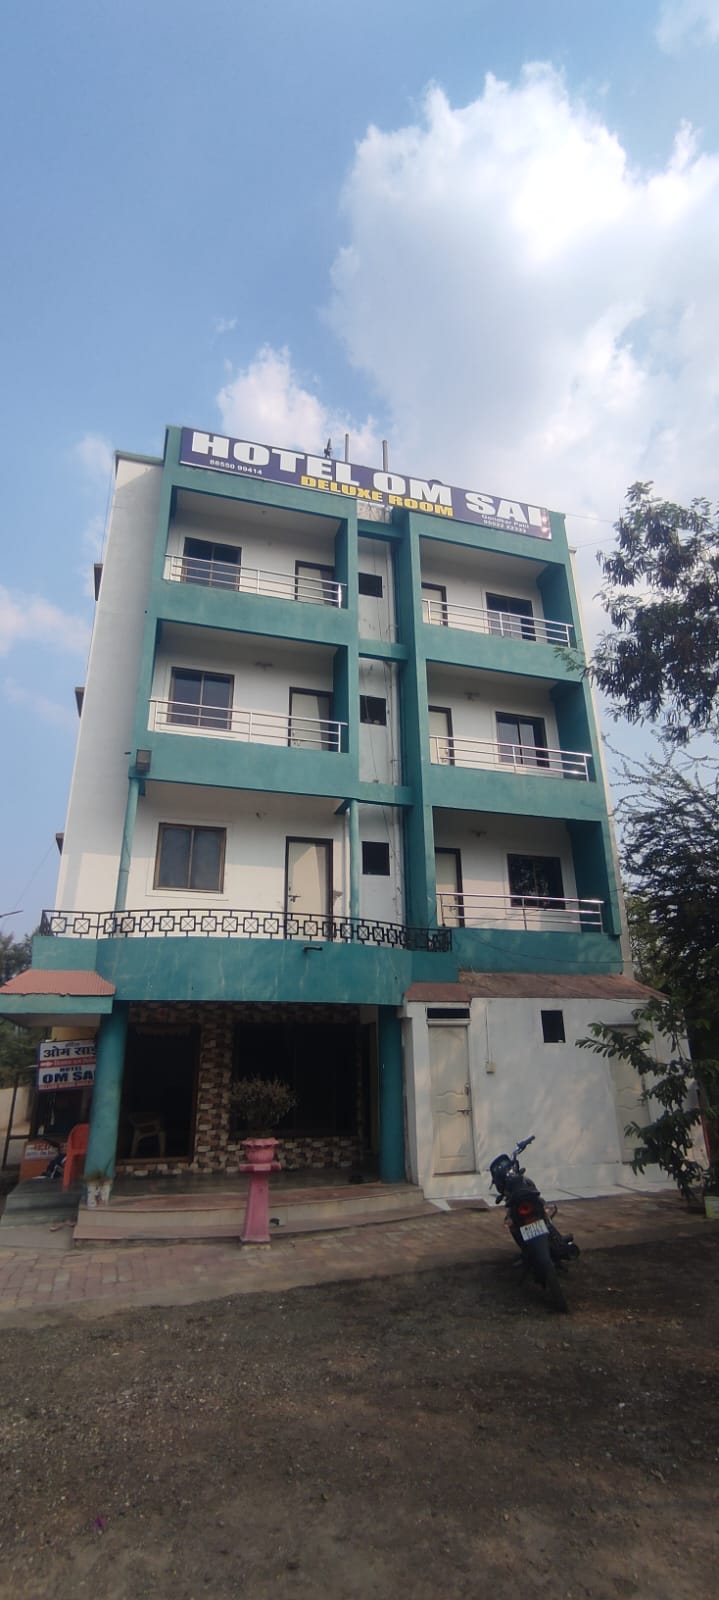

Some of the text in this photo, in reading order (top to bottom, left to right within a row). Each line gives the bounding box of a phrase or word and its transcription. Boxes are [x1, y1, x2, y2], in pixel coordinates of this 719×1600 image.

[191, 431, 543, 527] HOTEL OM SAI
[301, 475, 454, 517] DELUXE ROOM
[43, 1045, 70, 1058] ओम
[43, 1073, 68, 1084] OM
